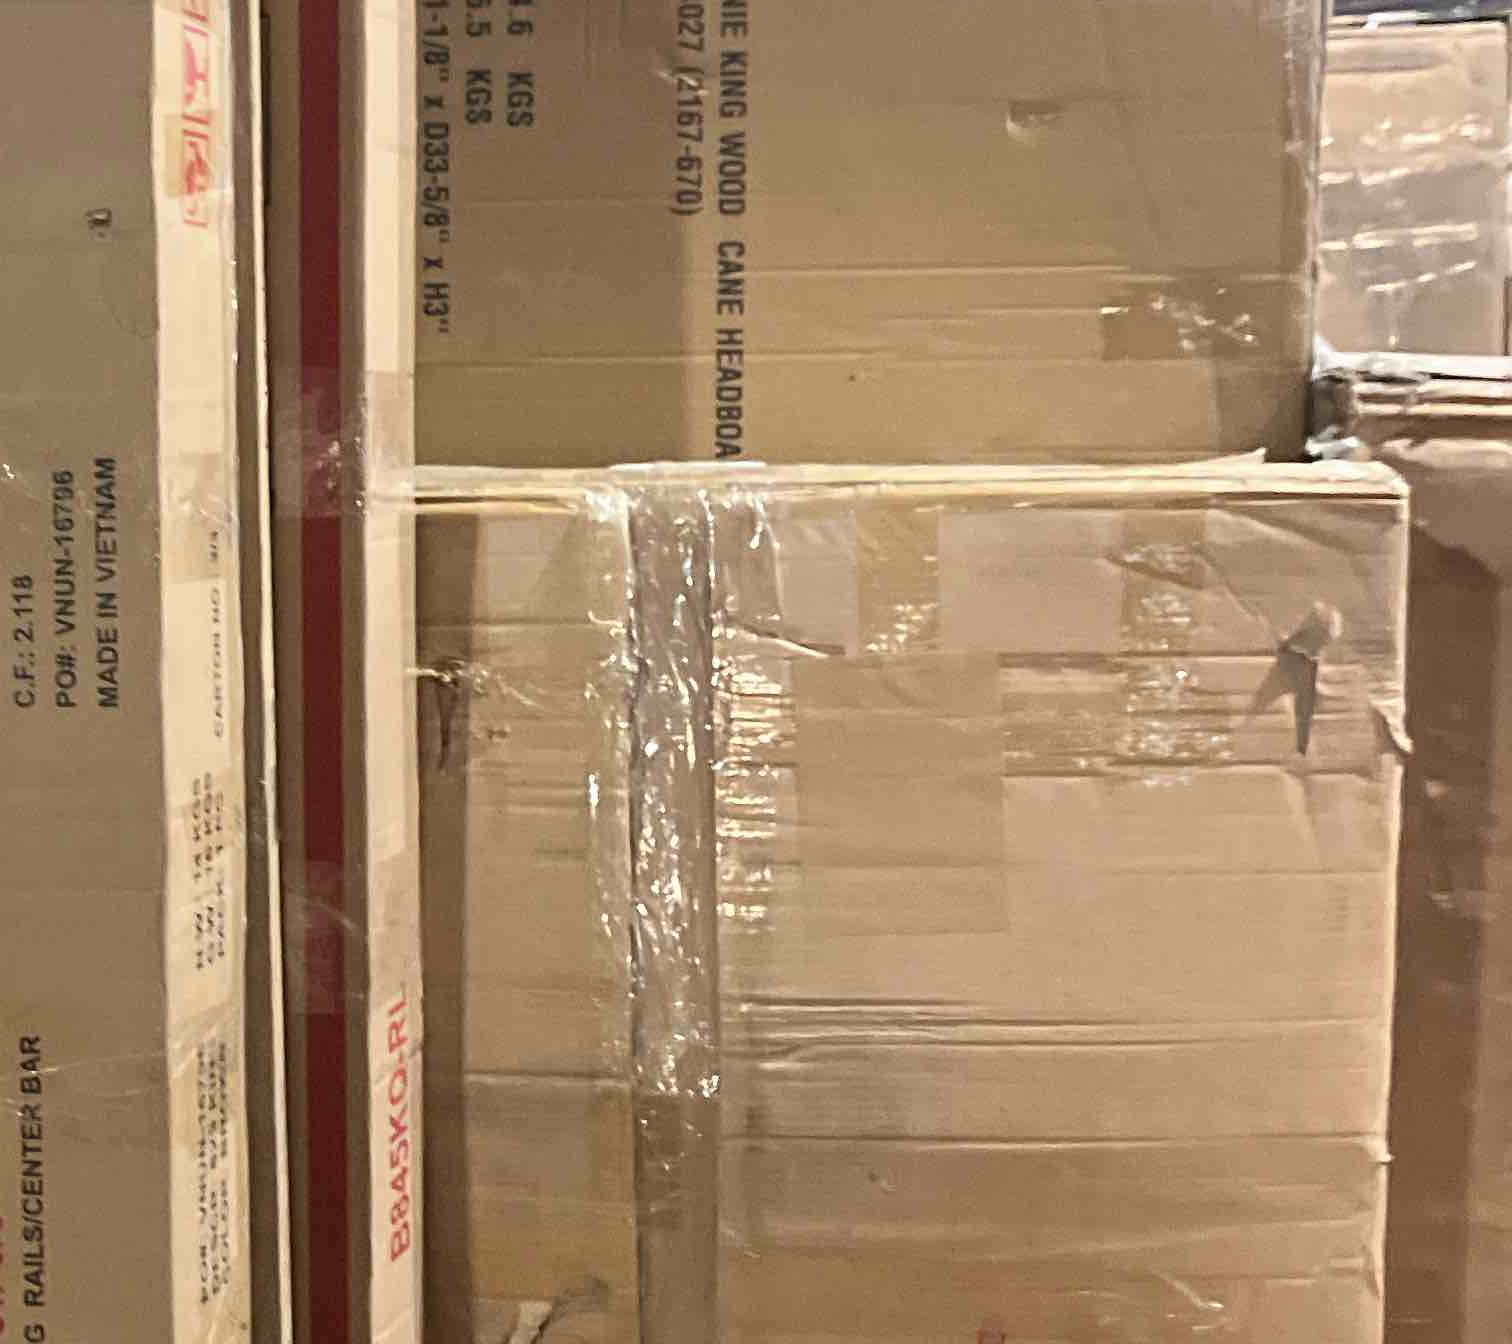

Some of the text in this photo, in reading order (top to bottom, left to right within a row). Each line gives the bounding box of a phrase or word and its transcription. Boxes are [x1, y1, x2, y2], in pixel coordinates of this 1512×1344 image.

[464, 69, 493, 126] KGS
[506, 71, 535, 129] KGS
[719, 50, 748, 119] KING
[669, 63, 706, 217] (2167-670)
[718, 131, 747, 216] WOOD
[421, 122, 451, 244] D33-5/8"
[422, 282, 450, 335] H3"
[716, 241, 745, 316] CANE
[93, 456, 120, 709] MADE IN VIETNAM
[10, 574, 36, 709] C.F.: 2.118
[54, 645, 79, 709] PO#:
[19, 1034, 43, 1096] BAR
[20, 1101, 47, 1308] RAILS/CENTER
